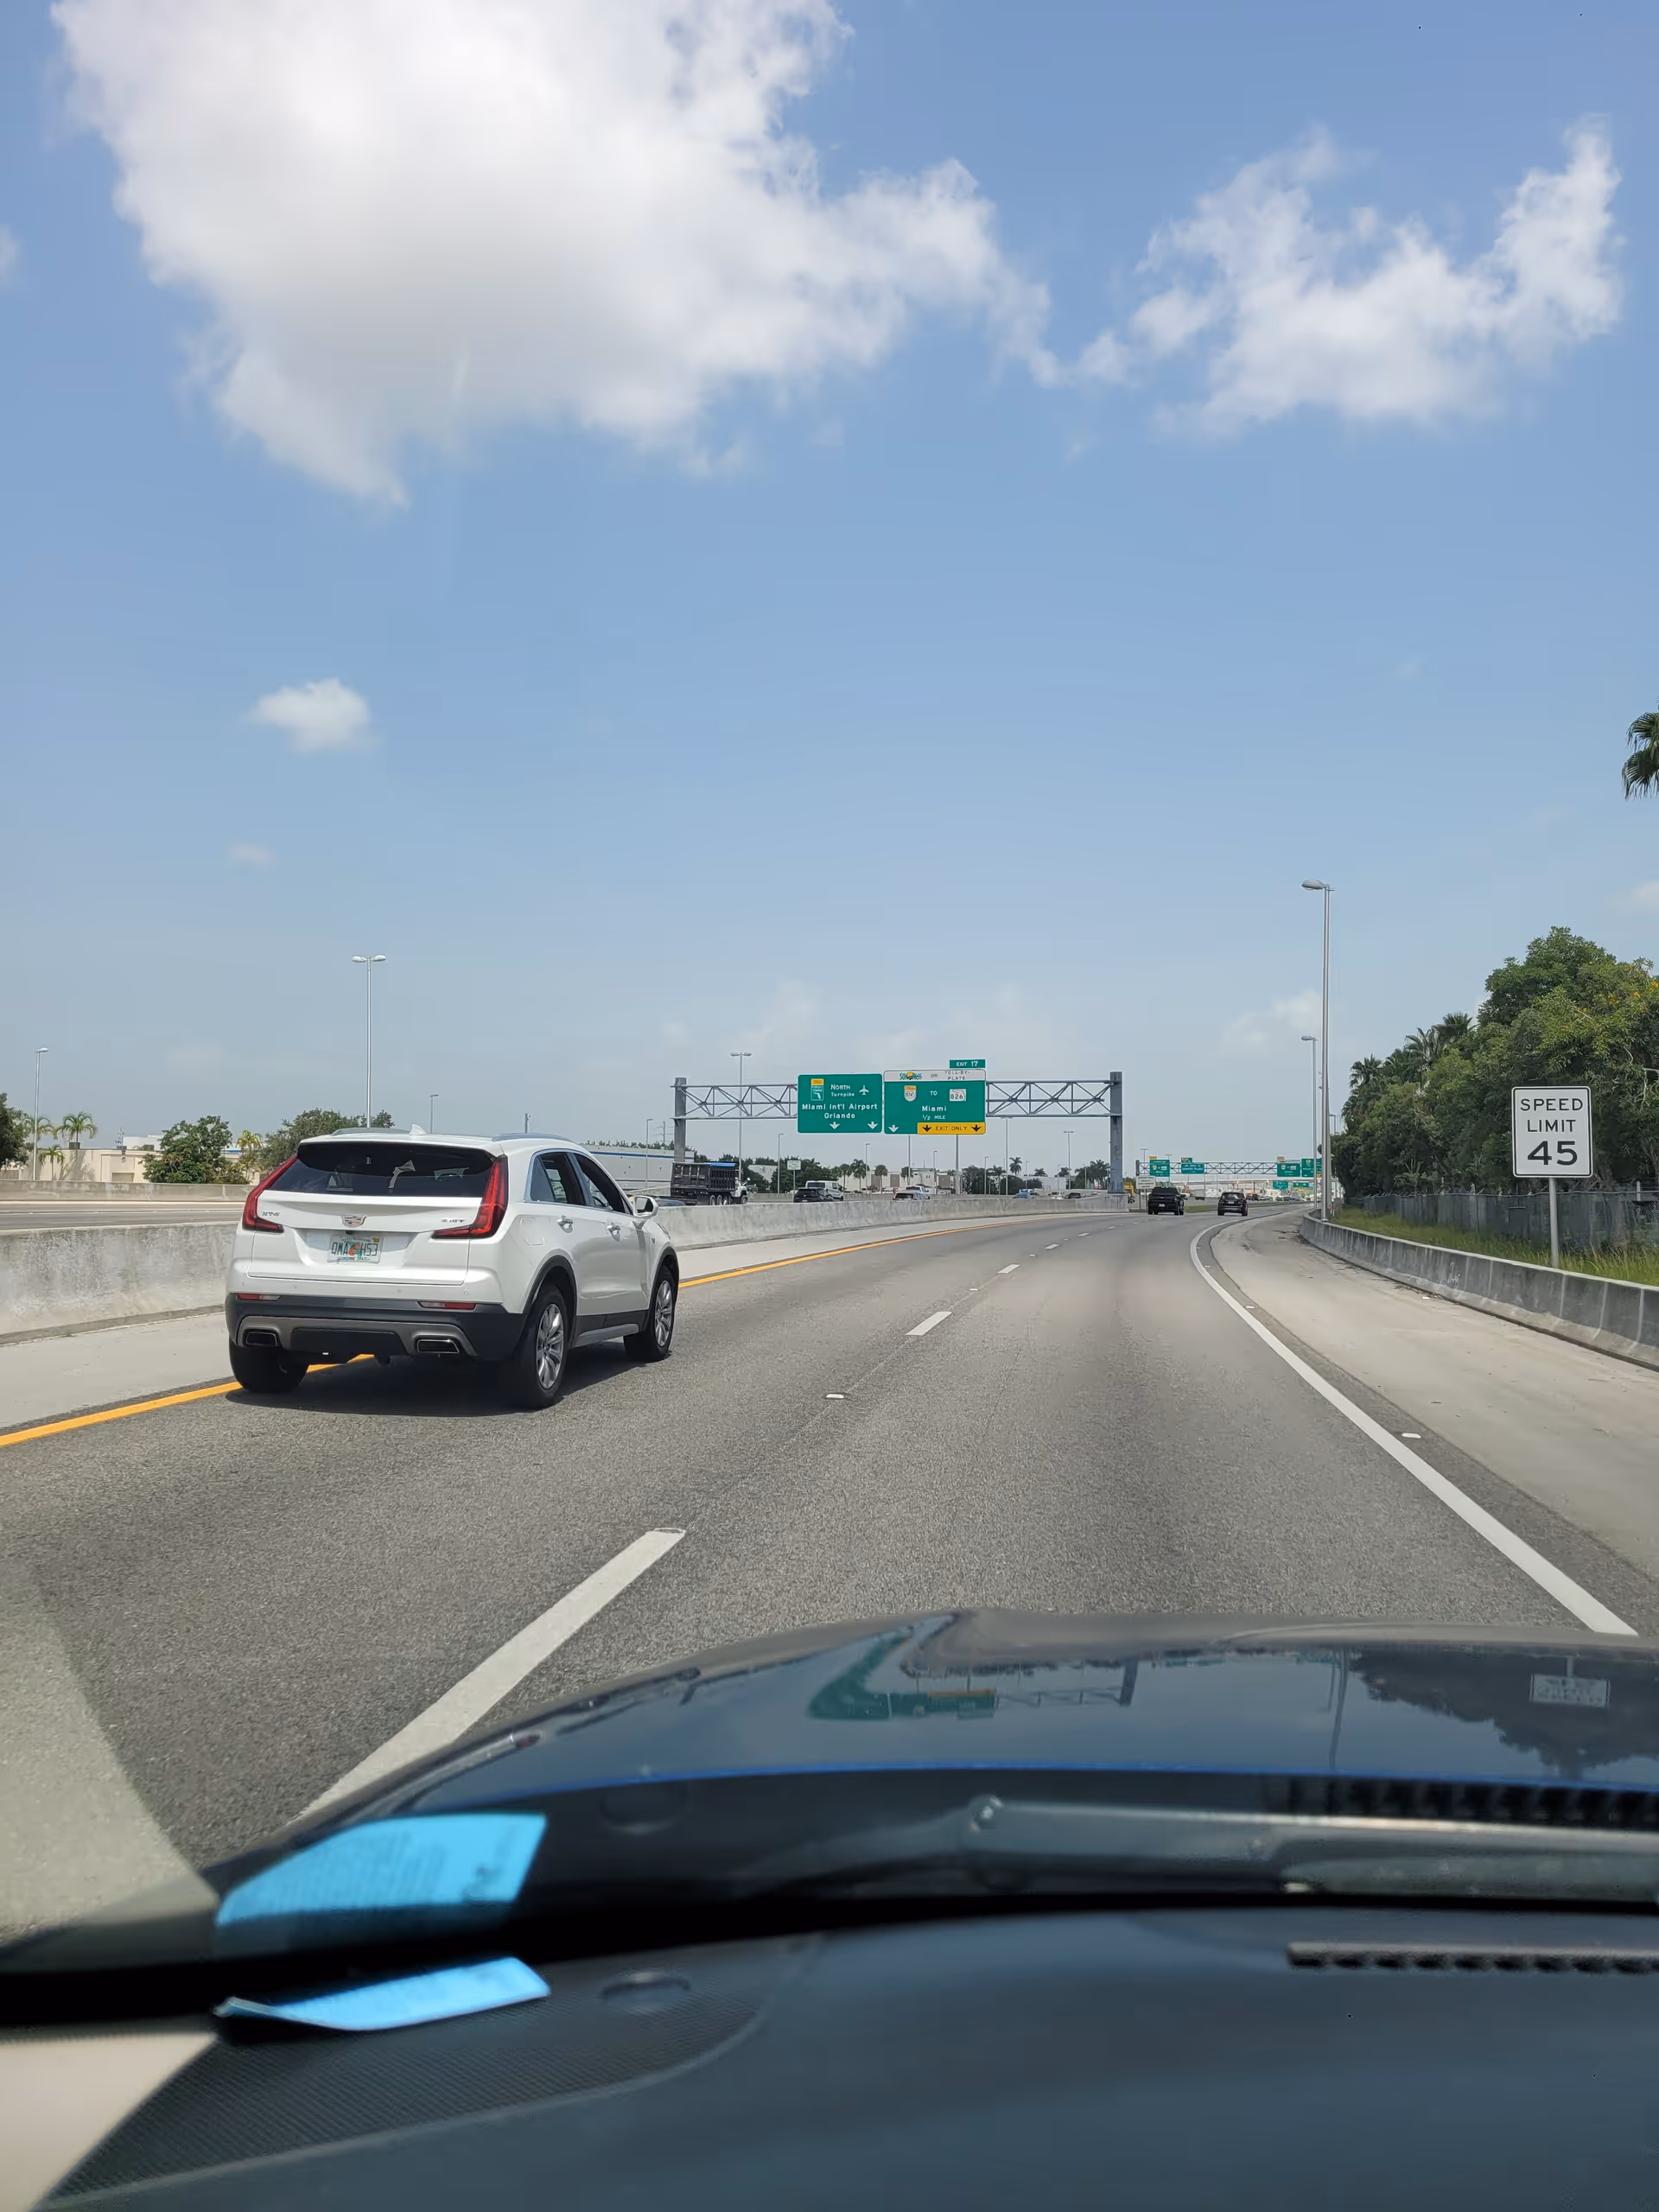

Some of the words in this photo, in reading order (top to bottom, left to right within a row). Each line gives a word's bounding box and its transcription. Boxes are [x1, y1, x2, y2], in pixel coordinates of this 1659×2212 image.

[1520, 1098, 1583, 1111] SPEED
[1527, 1119, 1576, 1132] LIMIT
[1527, 1140, 1577, 1166] 45
